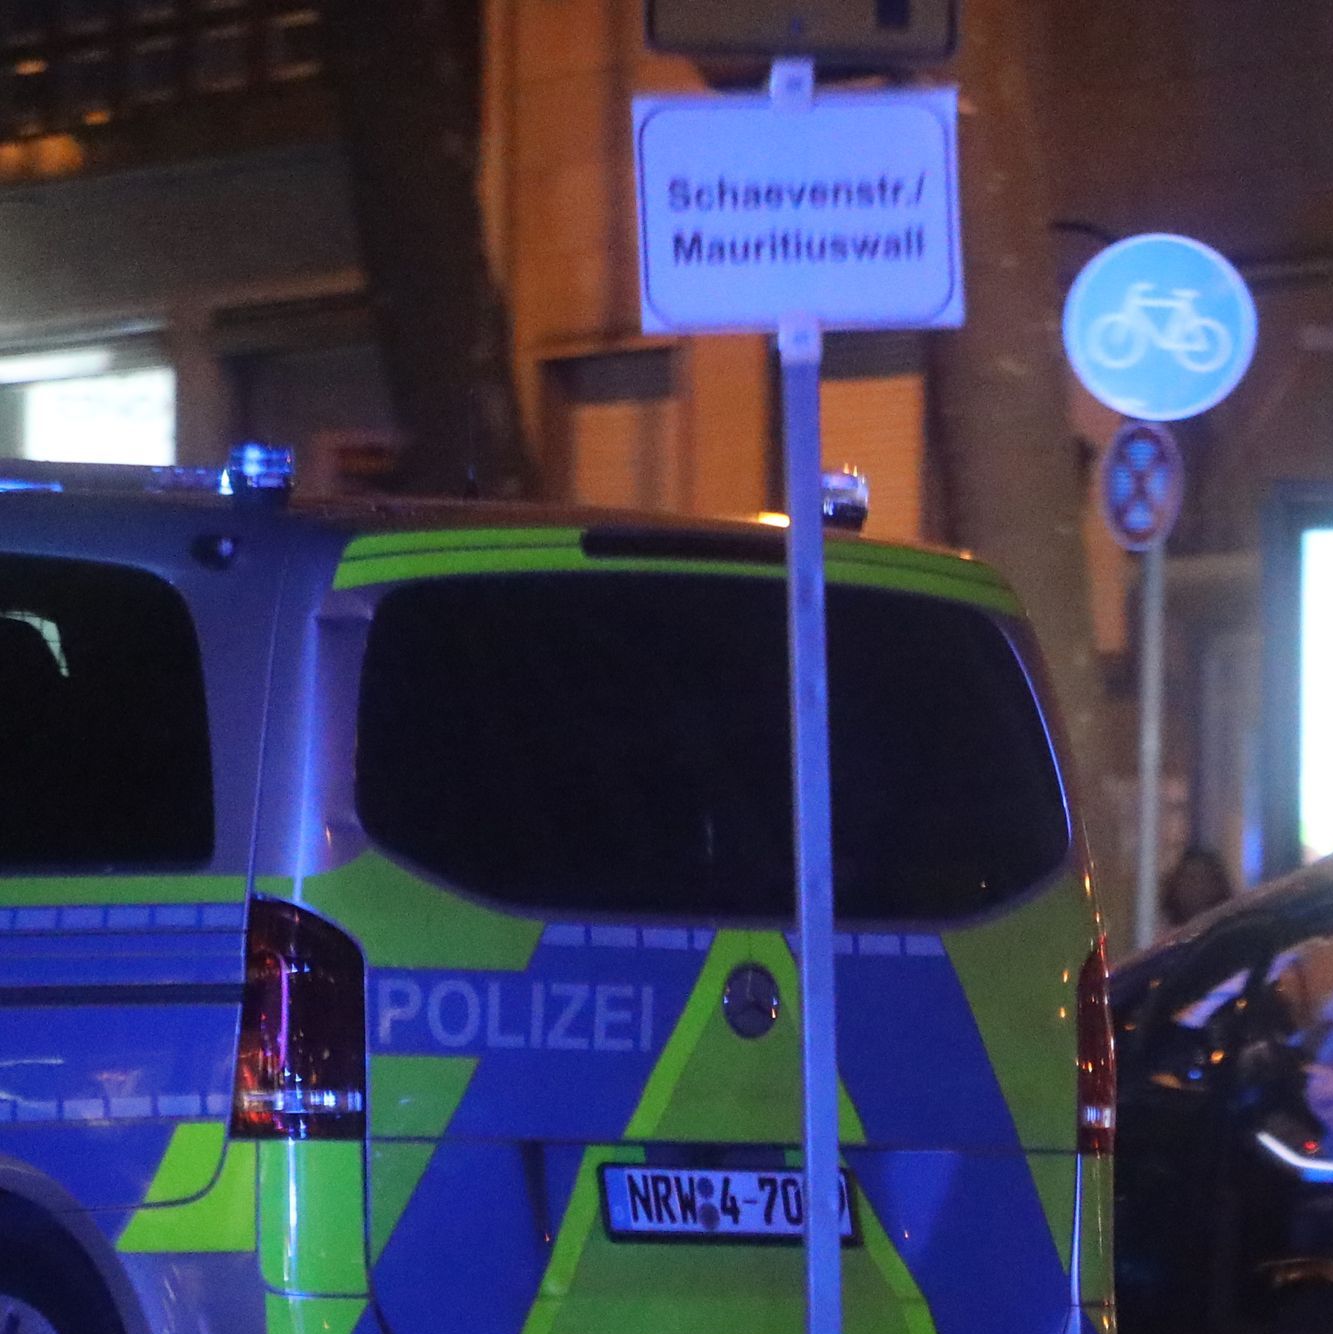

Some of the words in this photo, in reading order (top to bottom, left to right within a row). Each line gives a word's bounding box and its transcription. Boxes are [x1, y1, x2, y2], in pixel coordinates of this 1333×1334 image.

[672, 222, 925, 265] Mauritiuswall
[377, 977, 654, 1051] POLIZEI
[627, 1173, 697, 1224] NRW
